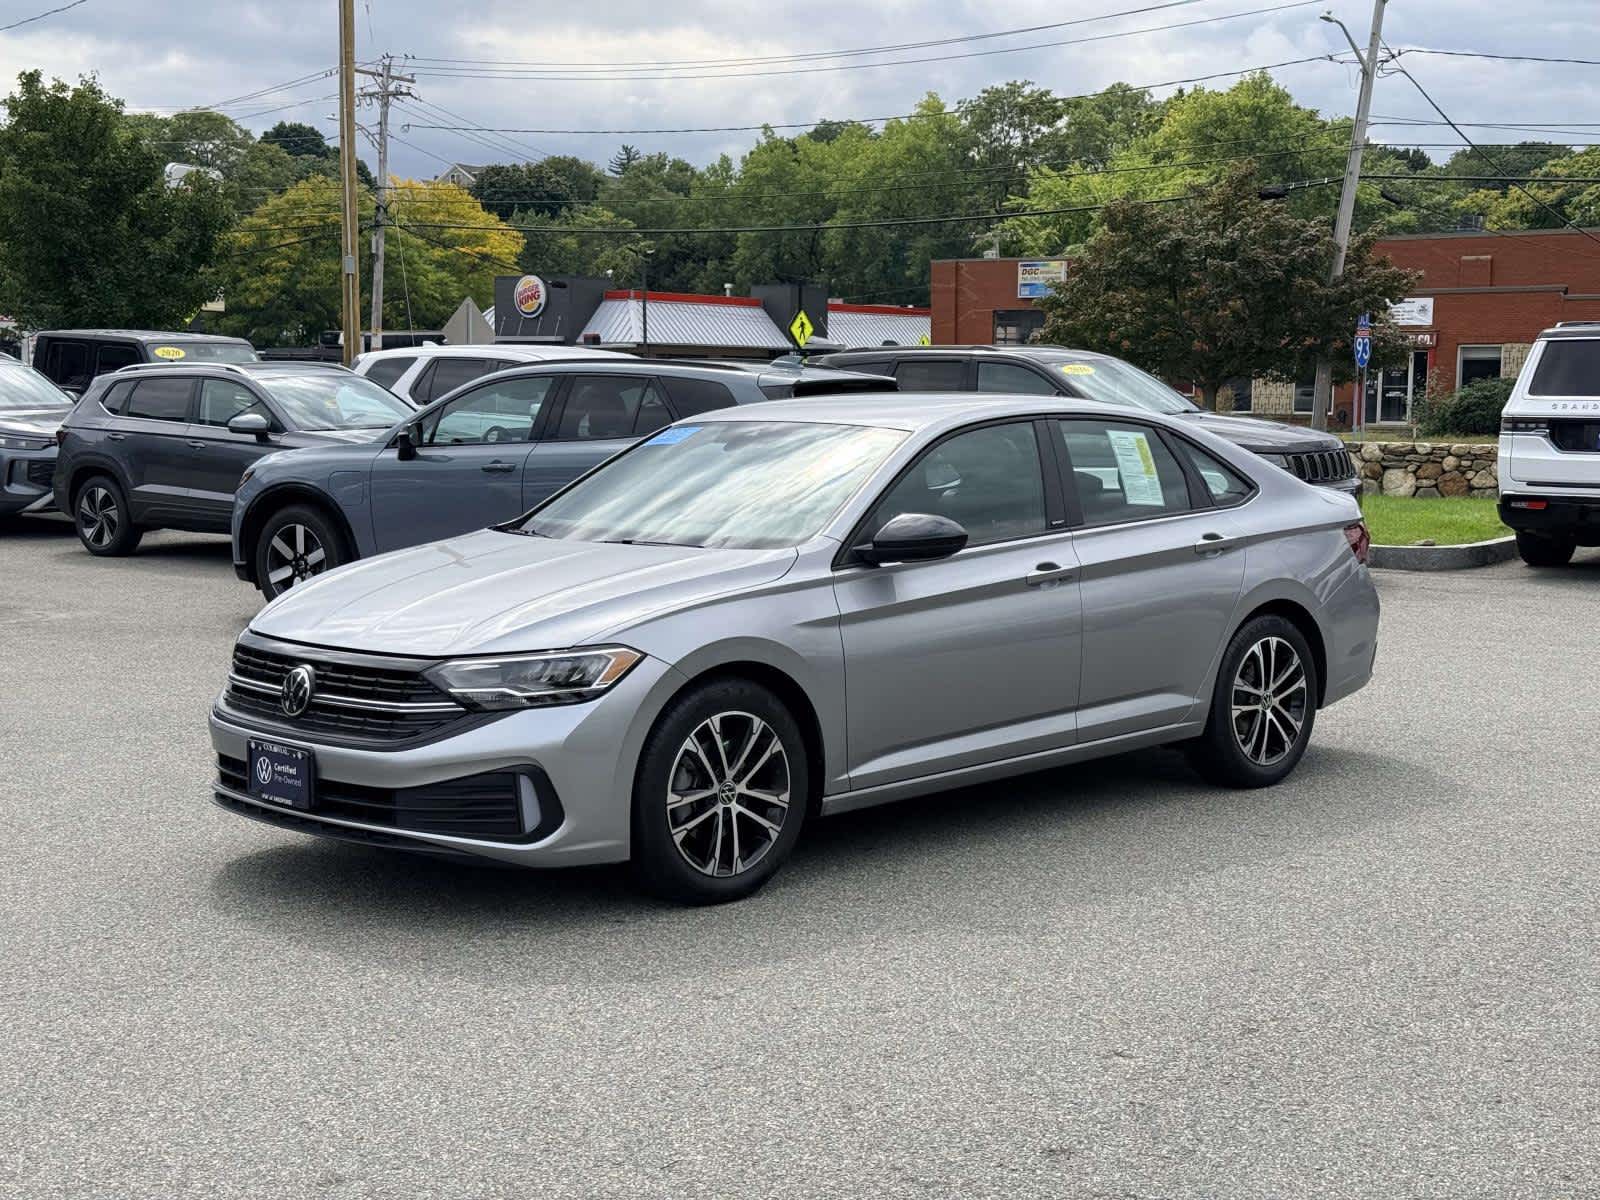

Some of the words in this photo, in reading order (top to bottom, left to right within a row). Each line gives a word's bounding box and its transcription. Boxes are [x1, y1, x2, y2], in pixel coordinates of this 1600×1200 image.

[1021, 268, 1040, 276] DGC
[518, 284, 539, 297] BURGER
[519, 290, 540, 307] KING
[1356, 338, 1370, 360] 93
[257, 757, 271, 783] VW
[273, 762, 297, 776] Certified
[274, 773, 302, 787] Pre-Owned
